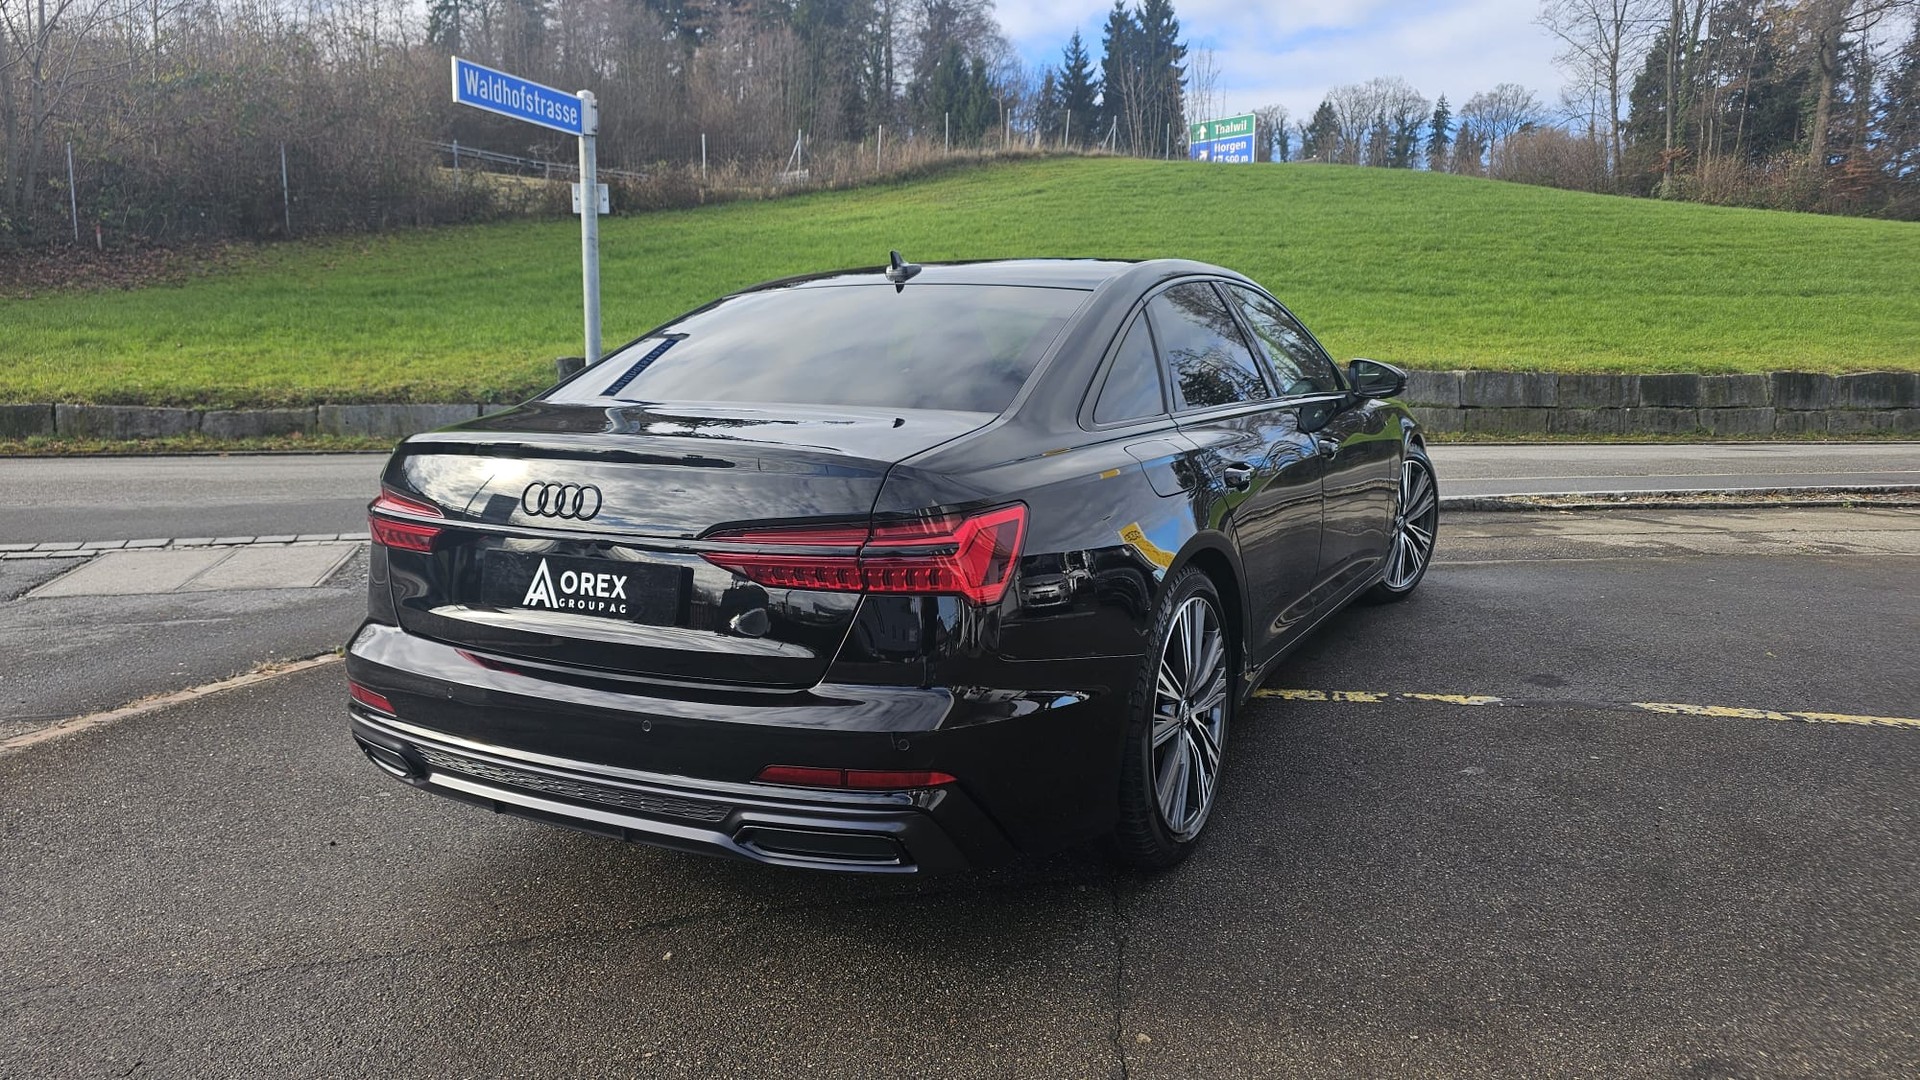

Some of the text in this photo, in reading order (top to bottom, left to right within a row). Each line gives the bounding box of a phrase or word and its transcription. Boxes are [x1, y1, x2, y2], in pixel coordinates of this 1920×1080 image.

[464, 67, 578, 125] Waldhofstrasse
[1215, 120, 1247, 134] Thalwil
[1214, 141, 1246, 153] Horgen
[559, 598, 626, 613] GROUP AG
